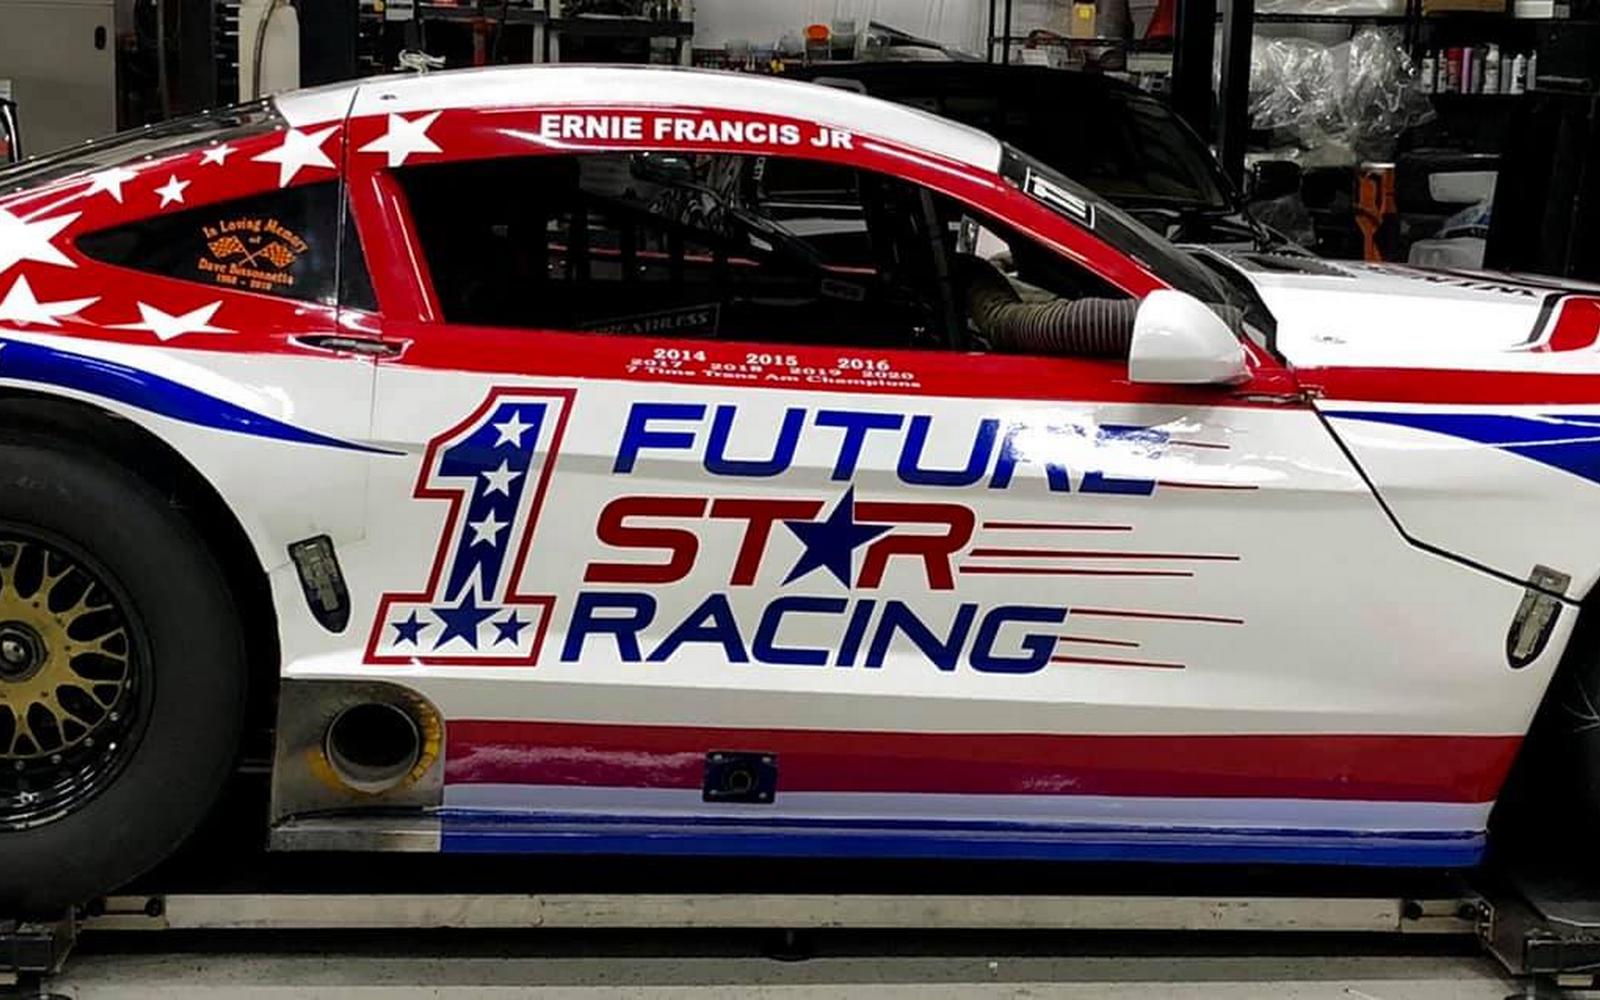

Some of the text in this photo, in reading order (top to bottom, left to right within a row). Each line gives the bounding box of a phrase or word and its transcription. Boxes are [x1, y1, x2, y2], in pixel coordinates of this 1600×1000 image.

[540, 114, 853, 149] ERNIE FRANCIS JR
[219, 217, 261, 233] Loving
[263, 219, 308, 254] Memory
[197, 257, 227, 274] Dave
[630, 357, 915, 381] 2017 2018 2019 2020
[653, 348, 890, 371] 2014 2015 2016
[645, 366, 697, 377] Time
[702, 369, 759, 380] Trans
[764, 373, 800, 383] Am
[805, 375, 922, 389] Champions
[362, 386, 578, 667] 1
[560, 591, 1068, 675] RACING
